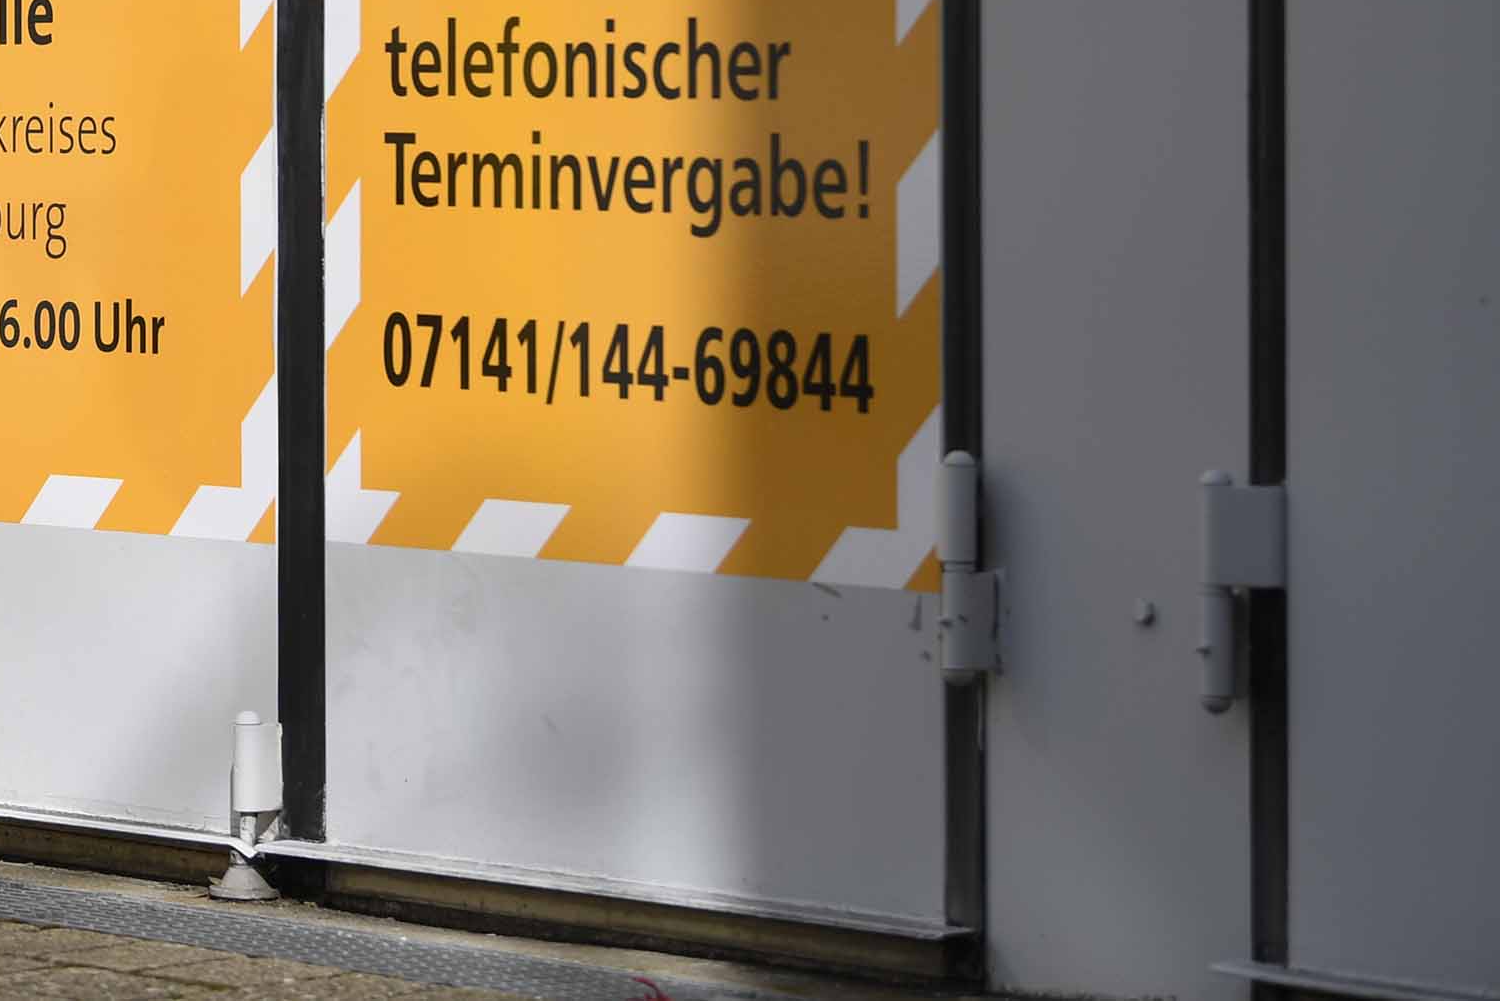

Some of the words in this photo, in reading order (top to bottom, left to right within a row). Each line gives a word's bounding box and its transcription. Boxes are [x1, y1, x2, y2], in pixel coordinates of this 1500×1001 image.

[384, 16, 792, 101] telefonischer
[383, 131, 871, 239] Terminvergabe!
[94, 298, 165, 355] Uhr
[383, 310, 875, 414] 07141/144-69844
